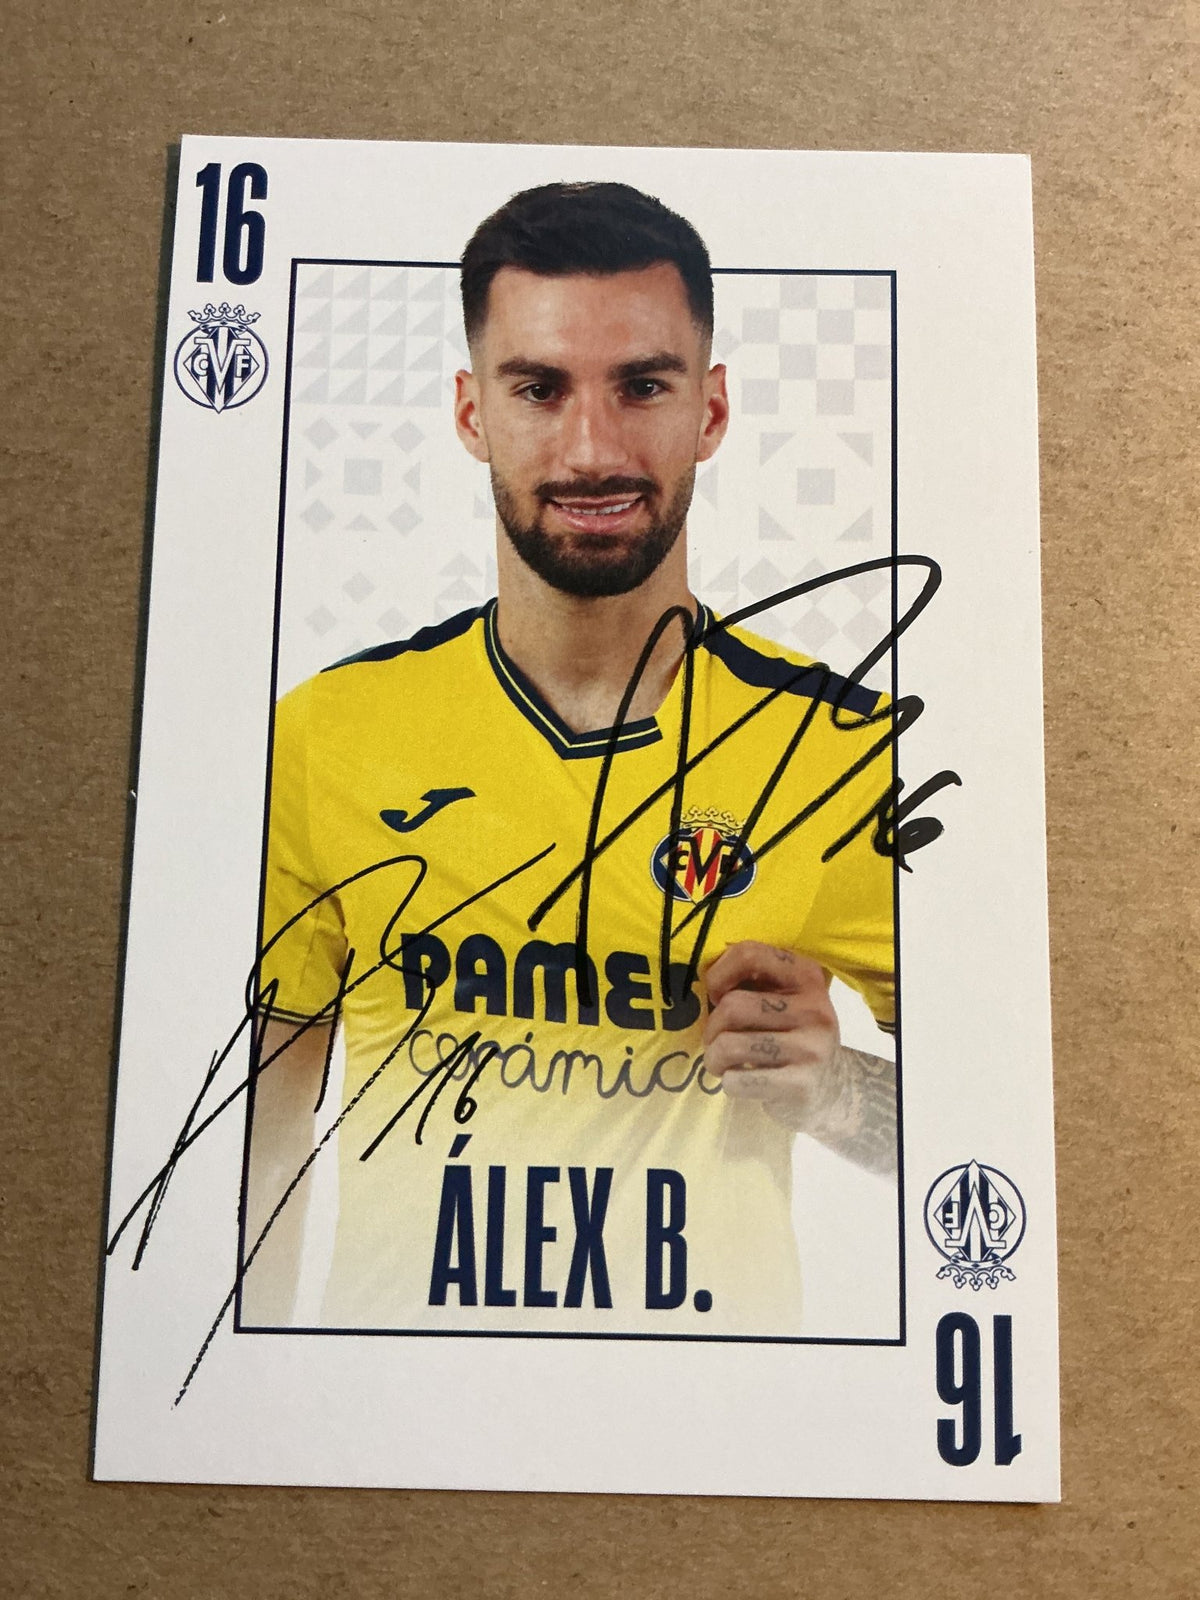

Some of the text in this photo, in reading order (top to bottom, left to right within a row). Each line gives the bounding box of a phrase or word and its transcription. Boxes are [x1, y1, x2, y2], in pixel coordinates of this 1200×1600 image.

[196, 162, 268, 286] 16
[400, 933, 714, 1032] PAMES
[428, 1133, 713, 1313] ÁLEX B.
[936, 1311, 1022, 1467] 16
